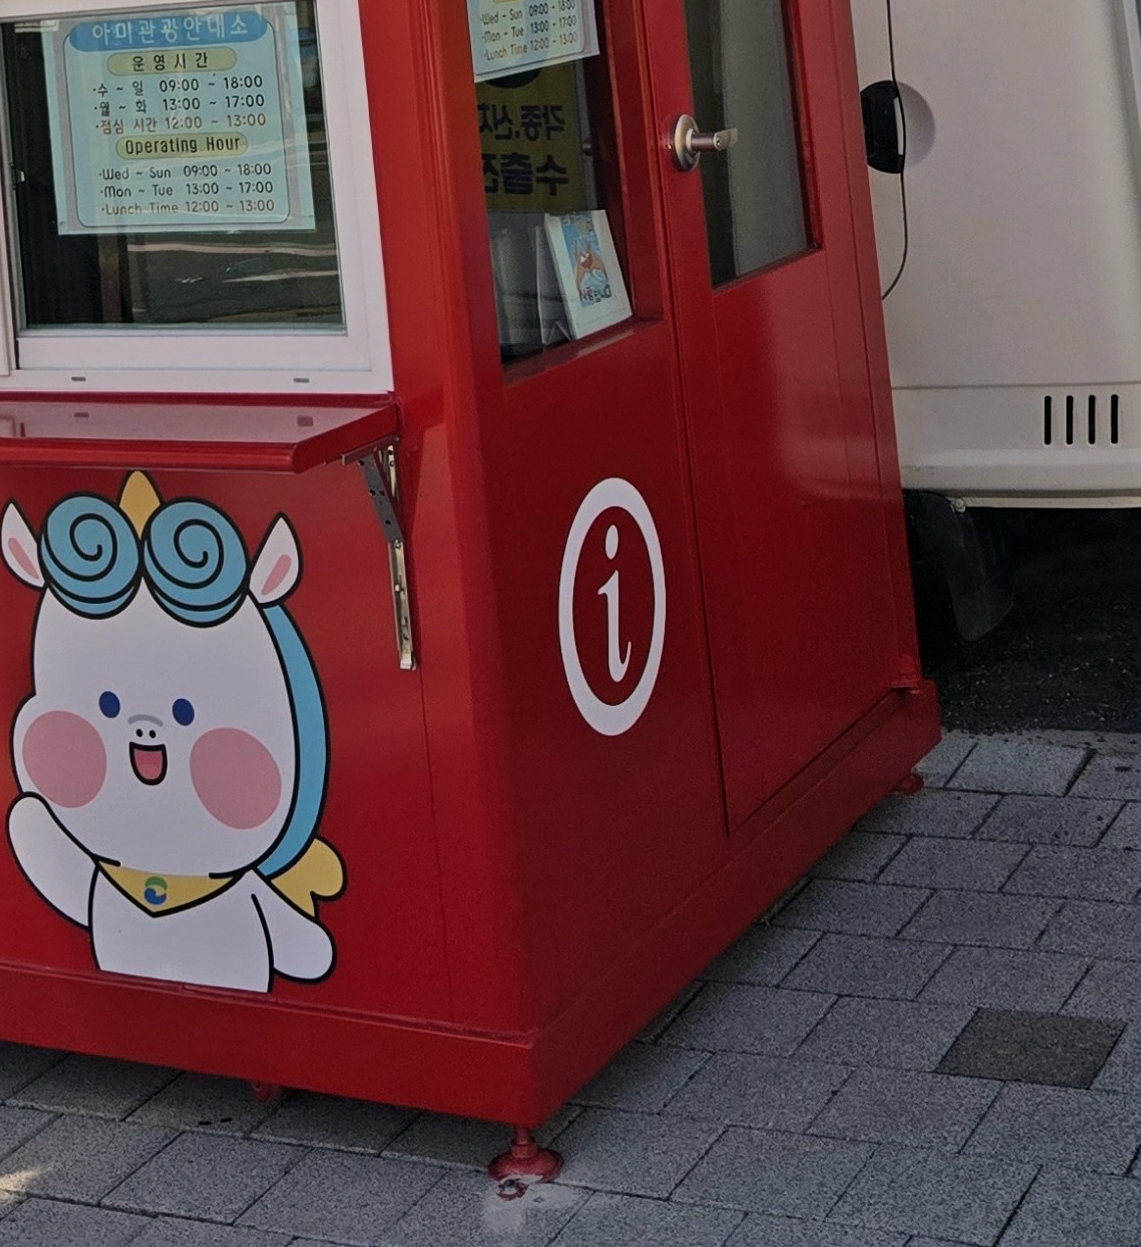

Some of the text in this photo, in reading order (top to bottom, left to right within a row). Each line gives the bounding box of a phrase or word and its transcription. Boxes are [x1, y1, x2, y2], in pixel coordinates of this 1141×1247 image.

[509, 9, 522, 21] Sun
[529, 2, 549, 17] 09:00
[92, 14, 248, 45] 아미관광안내소
[511, 26, 524, 37] Tue
[530, 20, 549, 33] 13:00
[559, 15, 576, 28] 17:00
[511, 43, 527, 53] Time
[530, 38, 549, 51] 12:00
[560, 32, 577, 45] 13:00
[132, 81, 144, 96] 일
[159, 78, 200, 93] 09:00
[224, 75, 263, 89] 18:00
[135, 100, 147, 114] 화
[163, 97, 201, 111] 13:00
[225, 94, 265, 108] 17:00
[133, 117, 156, 132] 시간
[165, 116, 202, 130] 12:00
[227, 113, 266, 127] 13:00
[126, 136, 241, 156] Operating Hour
[149, 167, 171, 179] Sun
[183, 165, 218, 177] 09:00
[237, 163, 271, 175] 18:00
[152, 185, 173, 196] Tue
[186, 183, 219, 195] 13:00
[239, 181, 273, 194] 17:00
[150, 203, 179, 214] Time
[186, 200, 219, 212] 12:00
[240, 199, 274, 212] 13:00
